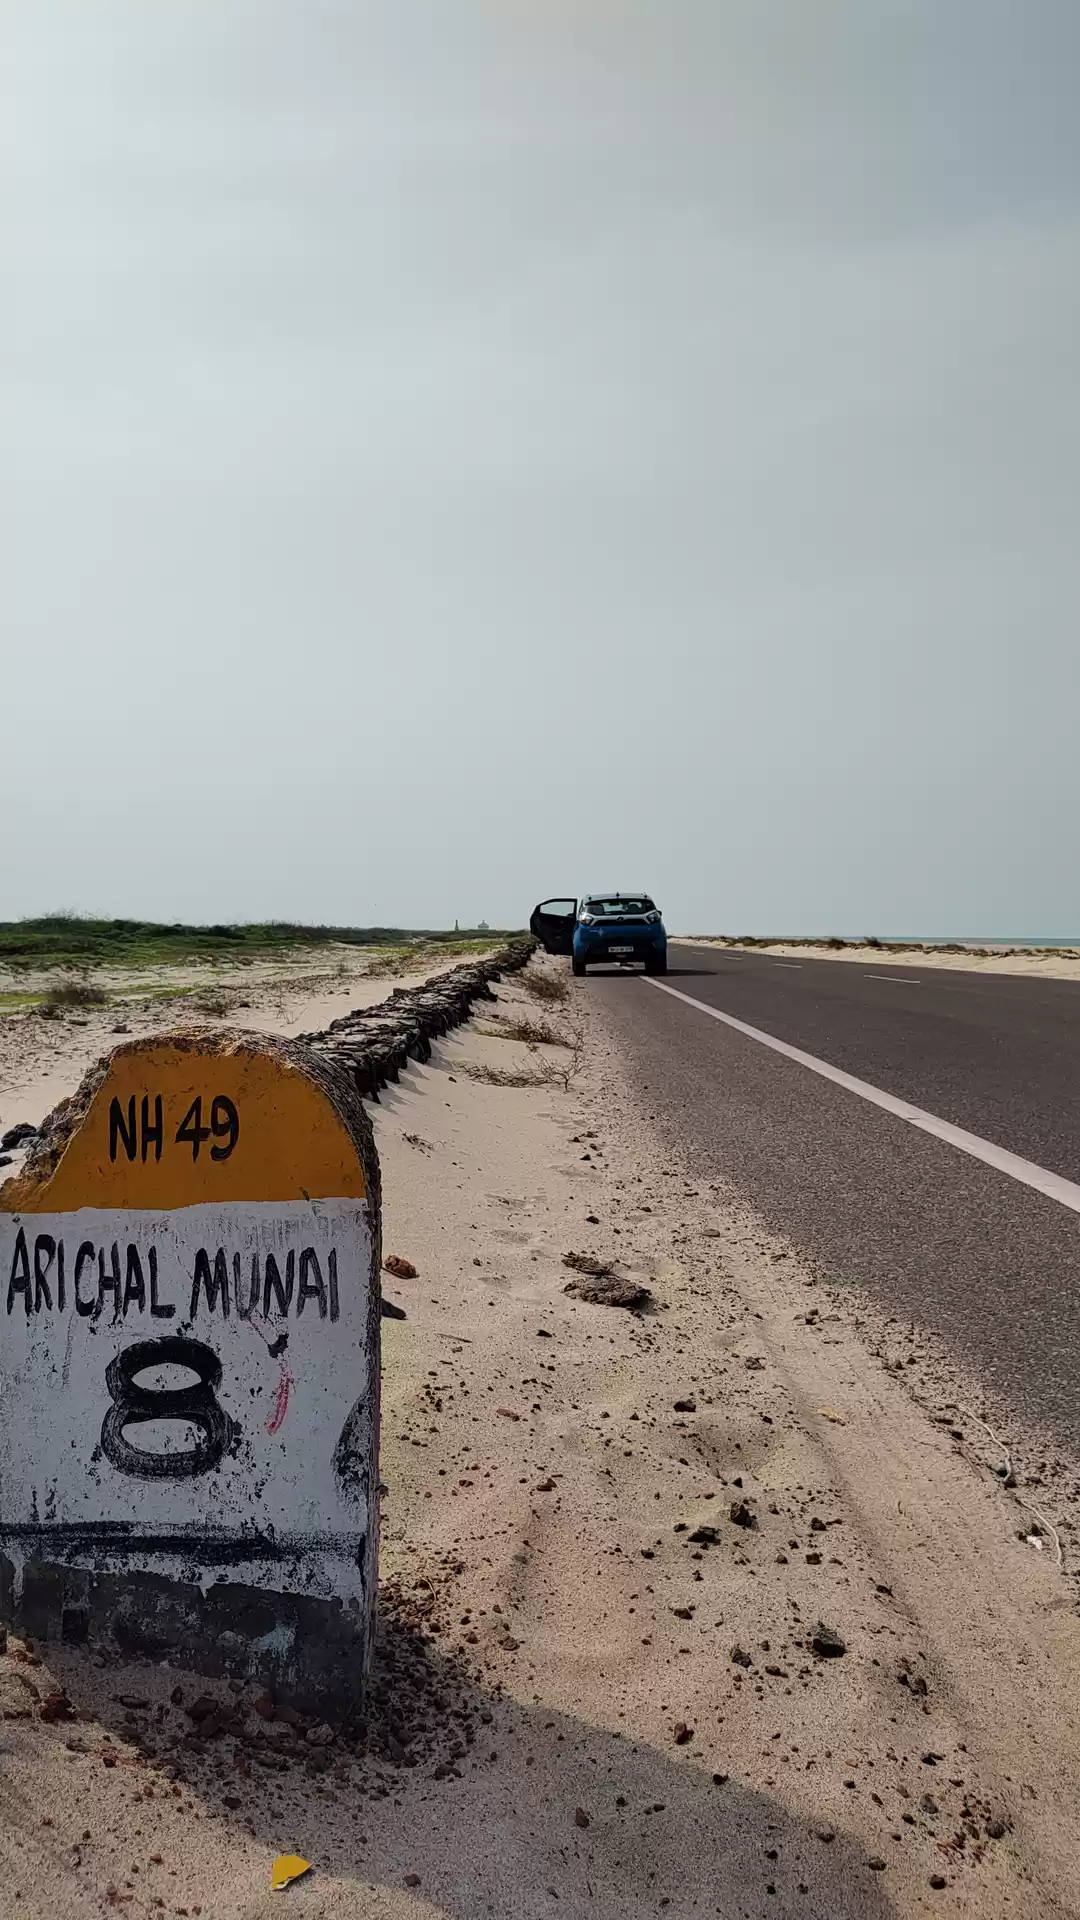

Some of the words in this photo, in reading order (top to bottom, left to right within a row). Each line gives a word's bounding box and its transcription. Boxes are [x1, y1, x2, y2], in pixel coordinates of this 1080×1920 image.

[109, 1093, 164, 1164] NH
[175, 1094, 240, 1162] 49
[6, 1227, 176, 1319] ARICHAL
[190, 1246, 340, 1323] MUNAI
[101, 1335, 236, 1482] 8
